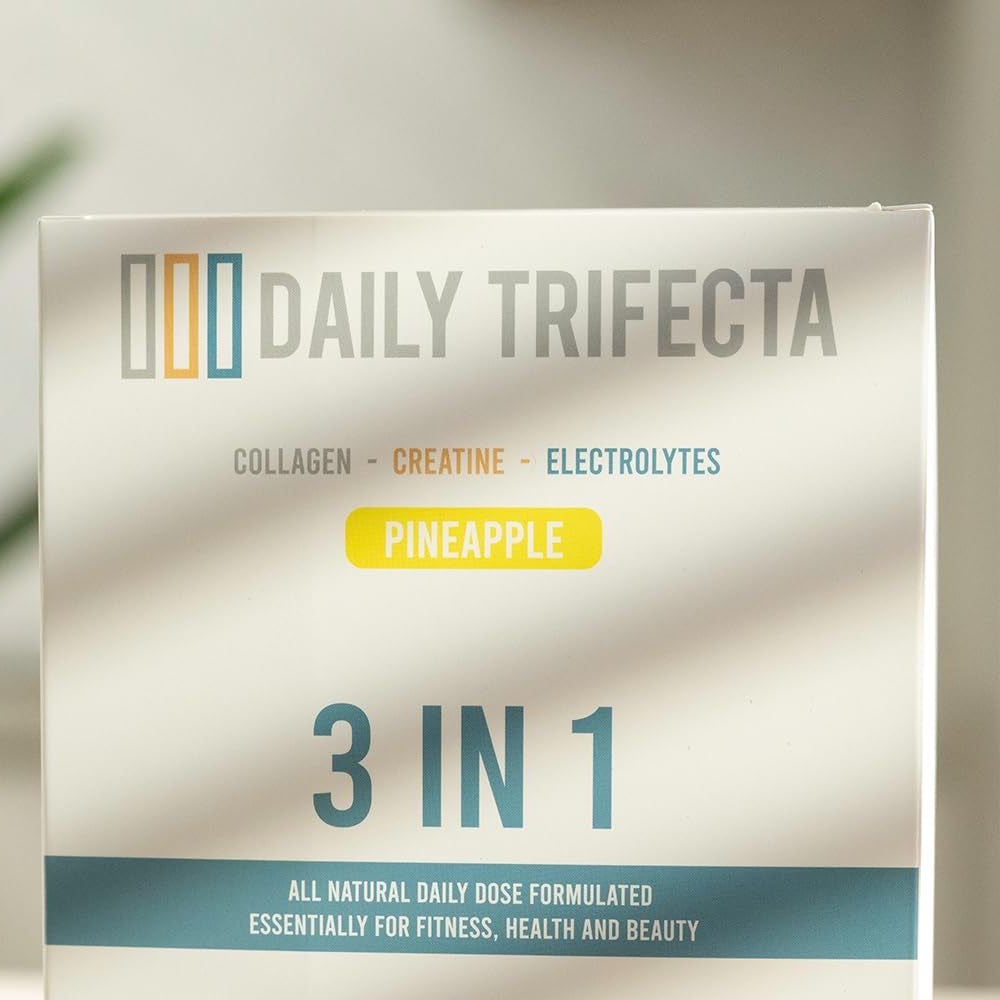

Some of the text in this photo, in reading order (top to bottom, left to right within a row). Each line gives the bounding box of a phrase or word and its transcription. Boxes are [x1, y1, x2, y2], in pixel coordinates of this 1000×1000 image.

[261, 268, 837, 358] DAILY TRIFECTA
[234, 448, 351, 475] COLLAGEN
[394, 448, 504, 475] CREATINE
[548, 448, 720, 475] ELECTROLYTES
[385, 521, 563, 558] PINEAPPLE
[313, 703, 612, 829] 3 IN 1
[289, 880, 652, 906] ALL NATURAL DAILY DOSE FORMULATED
[250, 913, 699, 941] ESSENTIALLY FOR FITNESS, HEALTH AND BEAUTY
